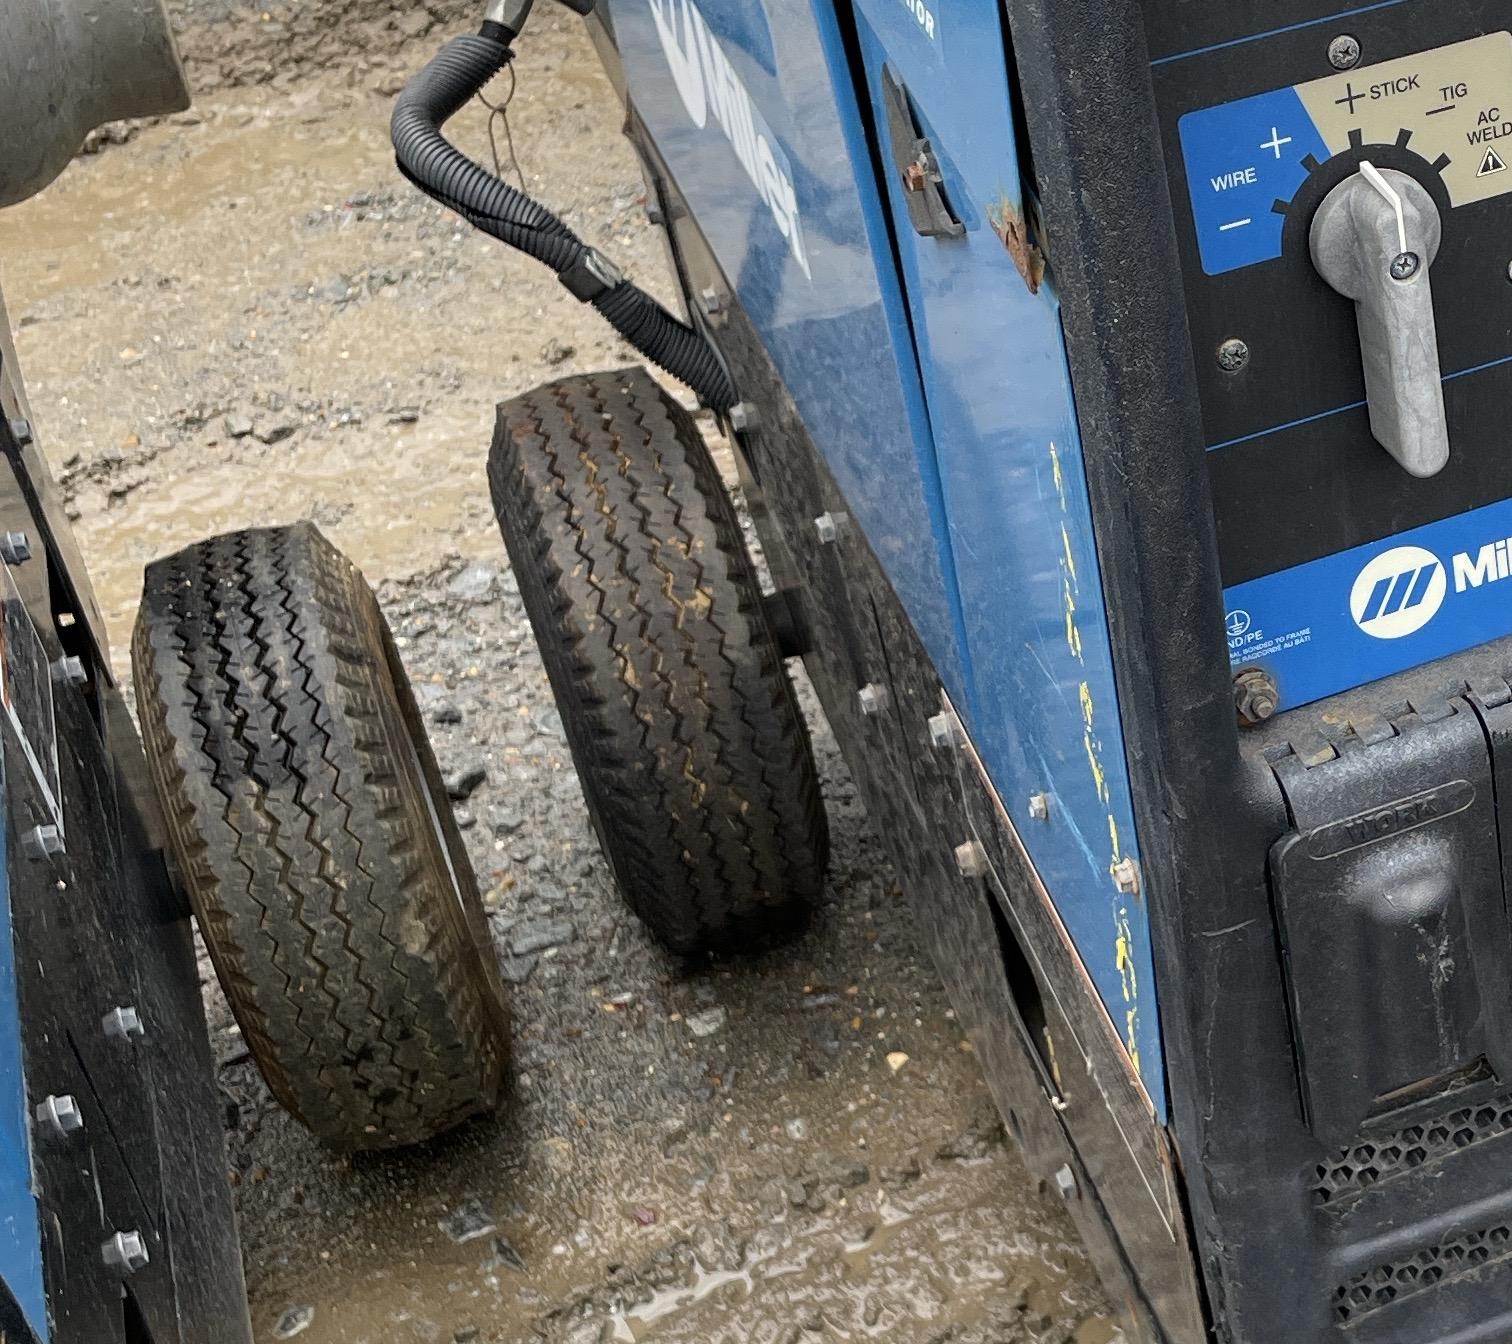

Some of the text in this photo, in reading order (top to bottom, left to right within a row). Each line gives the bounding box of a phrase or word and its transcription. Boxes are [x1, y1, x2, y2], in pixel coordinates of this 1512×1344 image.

[1369, 73, 1421, 100] STICK
[1439, 82, 1468, 102] TIG
[1476, 107, 1501, 127] AC
[1210, 167, 1258, 193] WIRE
